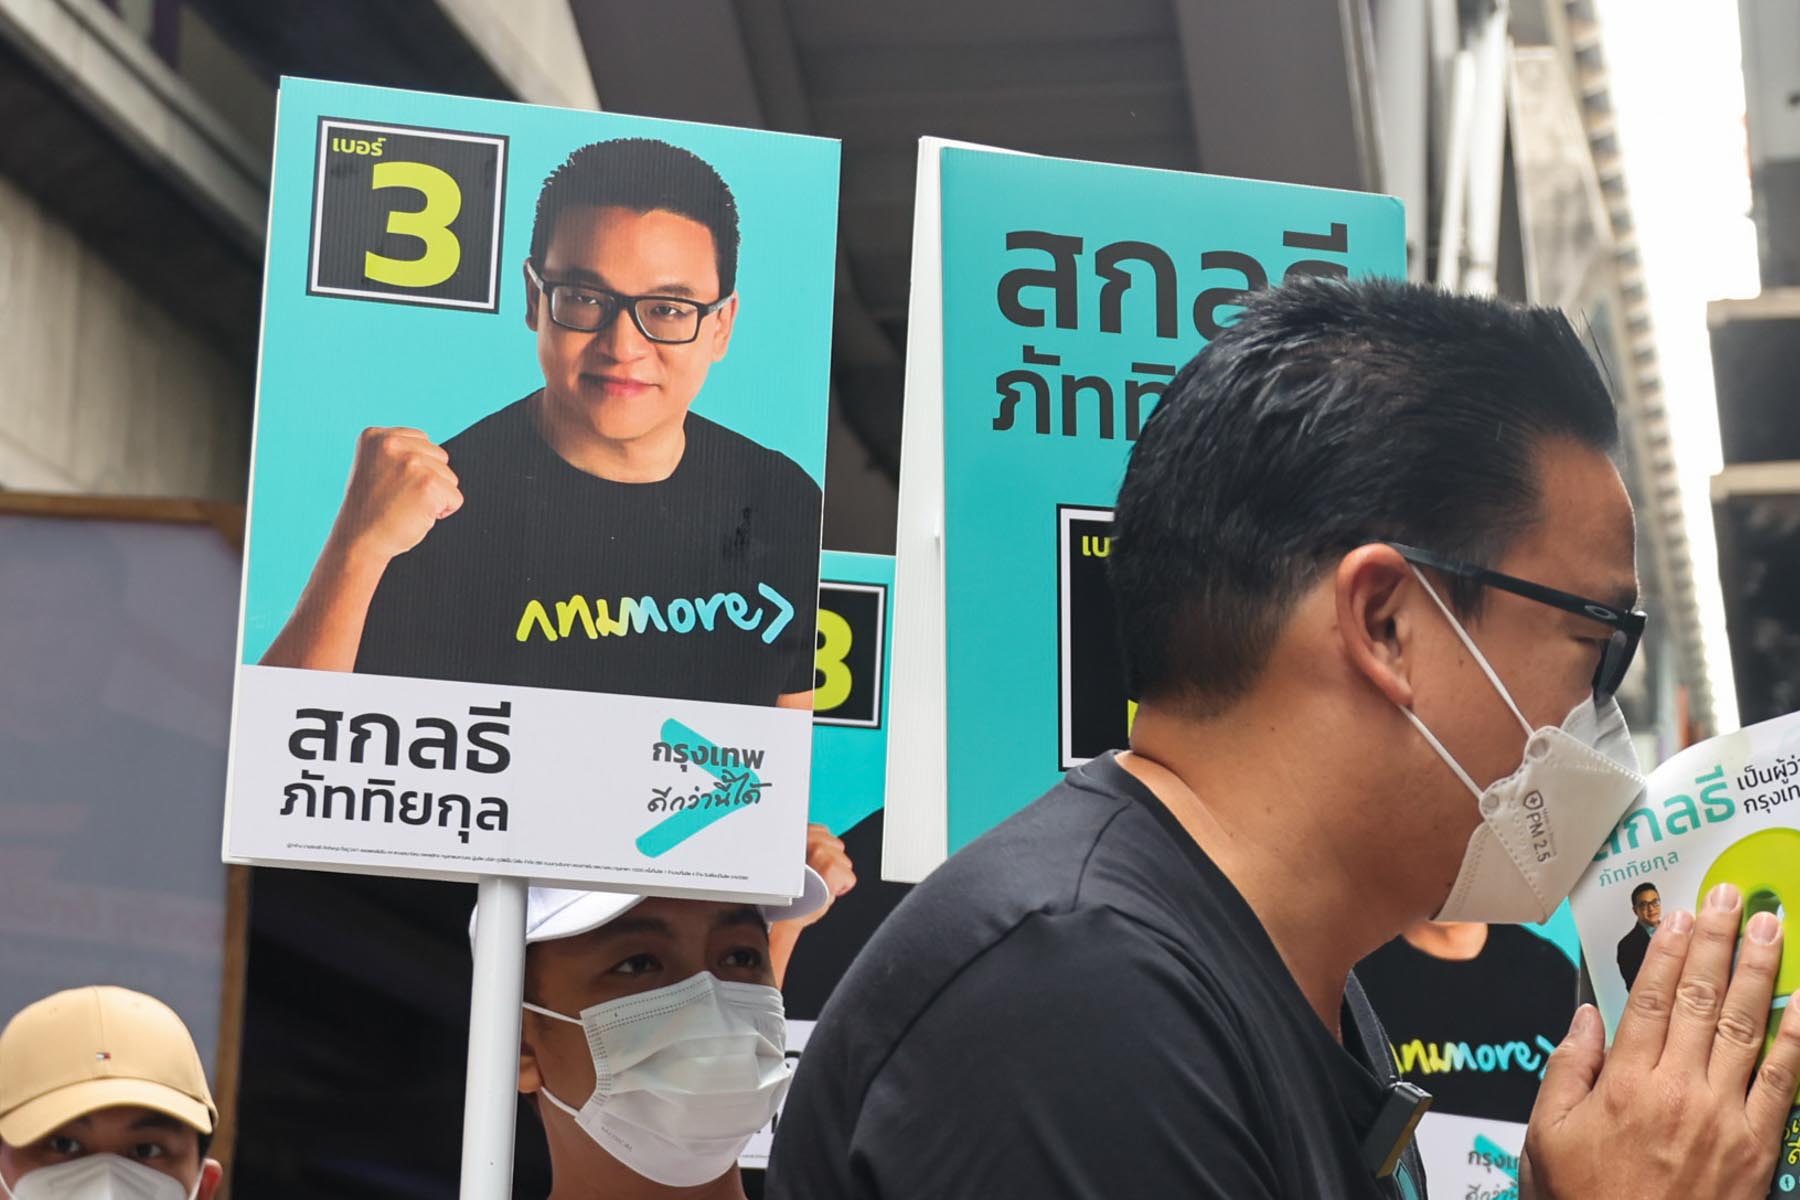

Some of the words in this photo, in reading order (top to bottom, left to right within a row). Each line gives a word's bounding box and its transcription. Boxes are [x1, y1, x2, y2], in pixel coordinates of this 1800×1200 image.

[332, 137, 387, 157] เบอร์
[364, 161, 462, 287] 3
[288, 701, 512, 775] สกลธี
[652, 741, 766, 773] กรุงเทพ
[279, 769, 510, 845] ภัททิยกุล
[647, 768, 773, 812] ดีกว่านี้ได้
[1526, 811, 1545, 839] PM
[1599, 850, 1680, 888] ภัททิยกุล
